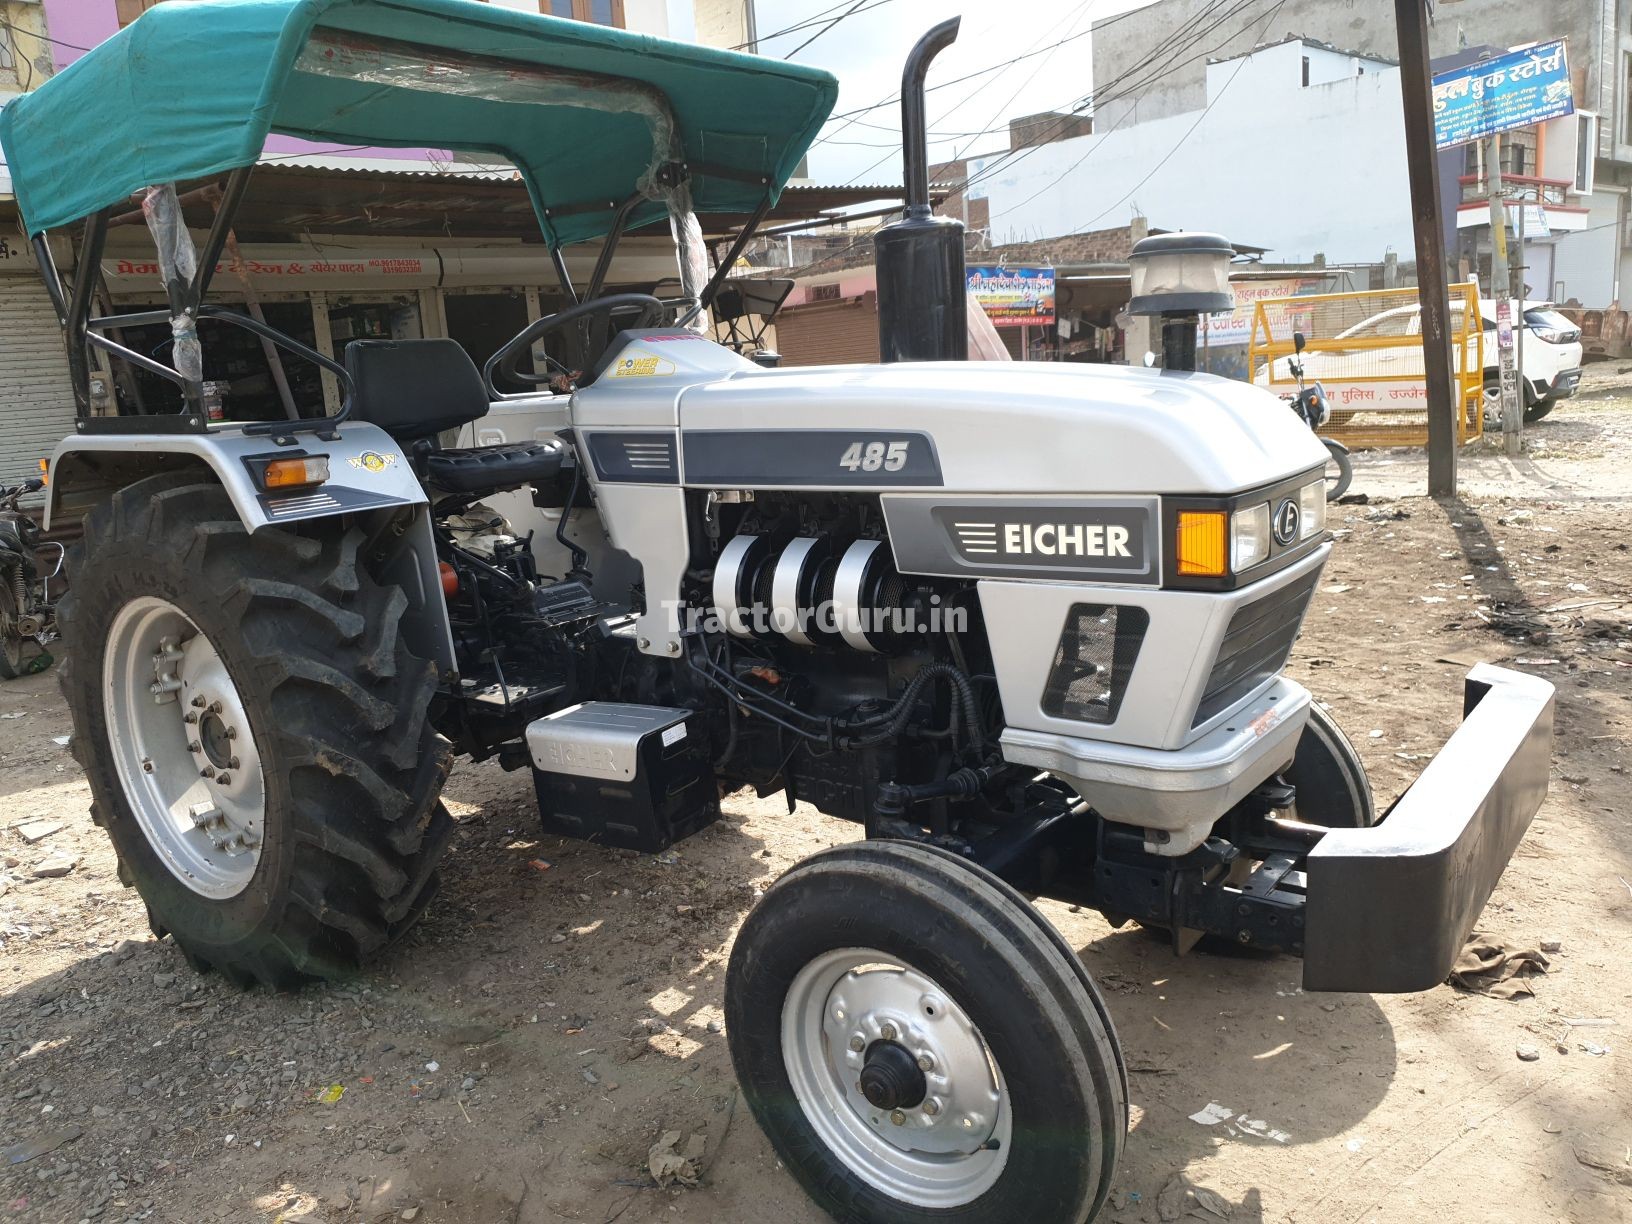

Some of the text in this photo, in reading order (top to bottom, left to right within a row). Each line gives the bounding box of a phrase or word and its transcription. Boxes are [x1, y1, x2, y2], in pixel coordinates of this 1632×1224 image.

[1471, 69, 1506, 99] बुक
[1509, 47, 1563, 81] स्टोर्स
[117, 260, 158, 275] प्रेम
[287, 262, 306, 275] &
[1236, 289, 1255, 302] राहुल
[618, 357, 660, 369] POWER
[616, 367, 656, 376] STEERING
[1341, 387, 1375, 404] पुलिस
[1388, 385, 1428, 401] उज्जैन
[840, 441, 909, 472] 485
[1004, 523, 1133, 558] EICHER
